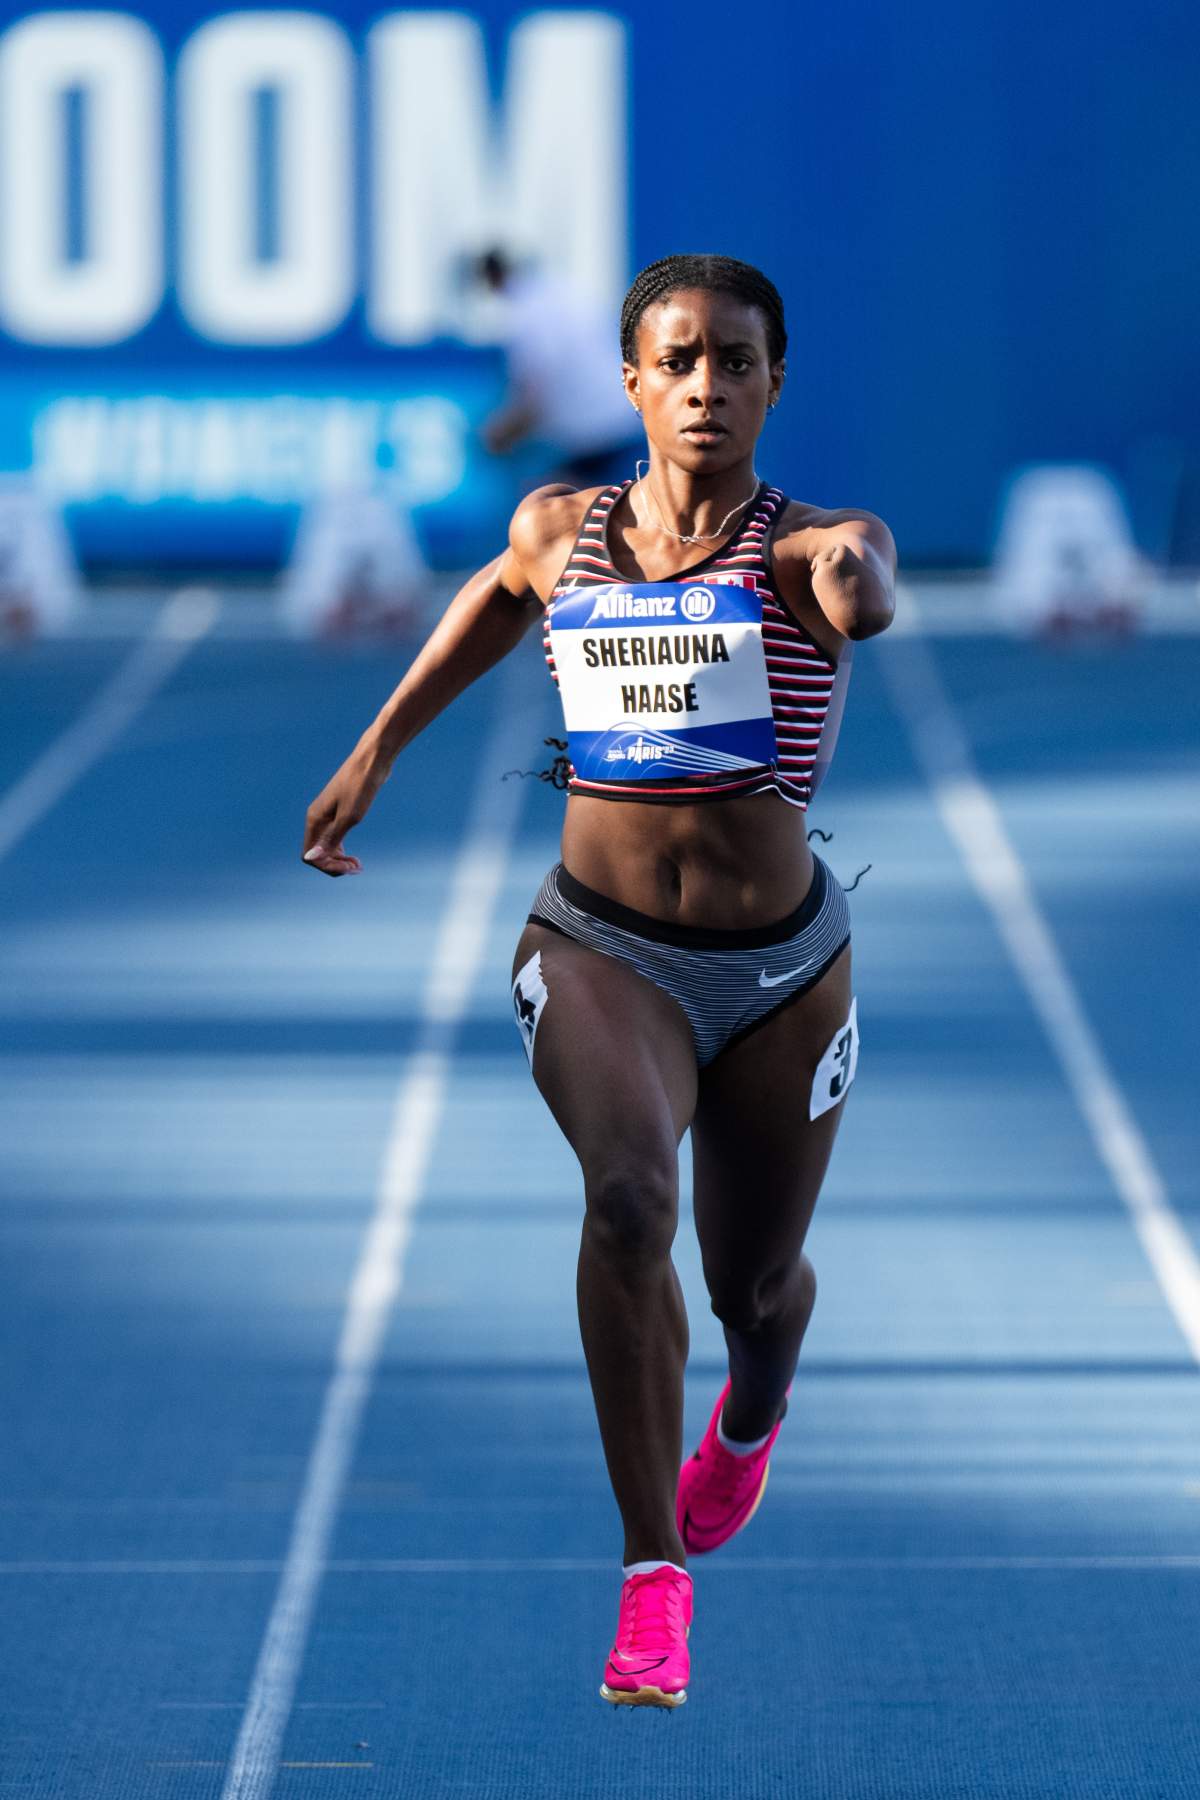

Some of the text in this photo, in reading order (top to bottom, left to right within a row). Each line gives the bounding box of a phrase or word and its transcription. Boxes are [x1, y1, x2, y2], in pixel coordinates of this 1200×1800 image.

[592, 592, 676, 619] Allianz
[583, 633, 730, 668] SHERIAUNA
[621, 682, 700, 713] HAASE
[829, 1027, 852, 1098] 3
